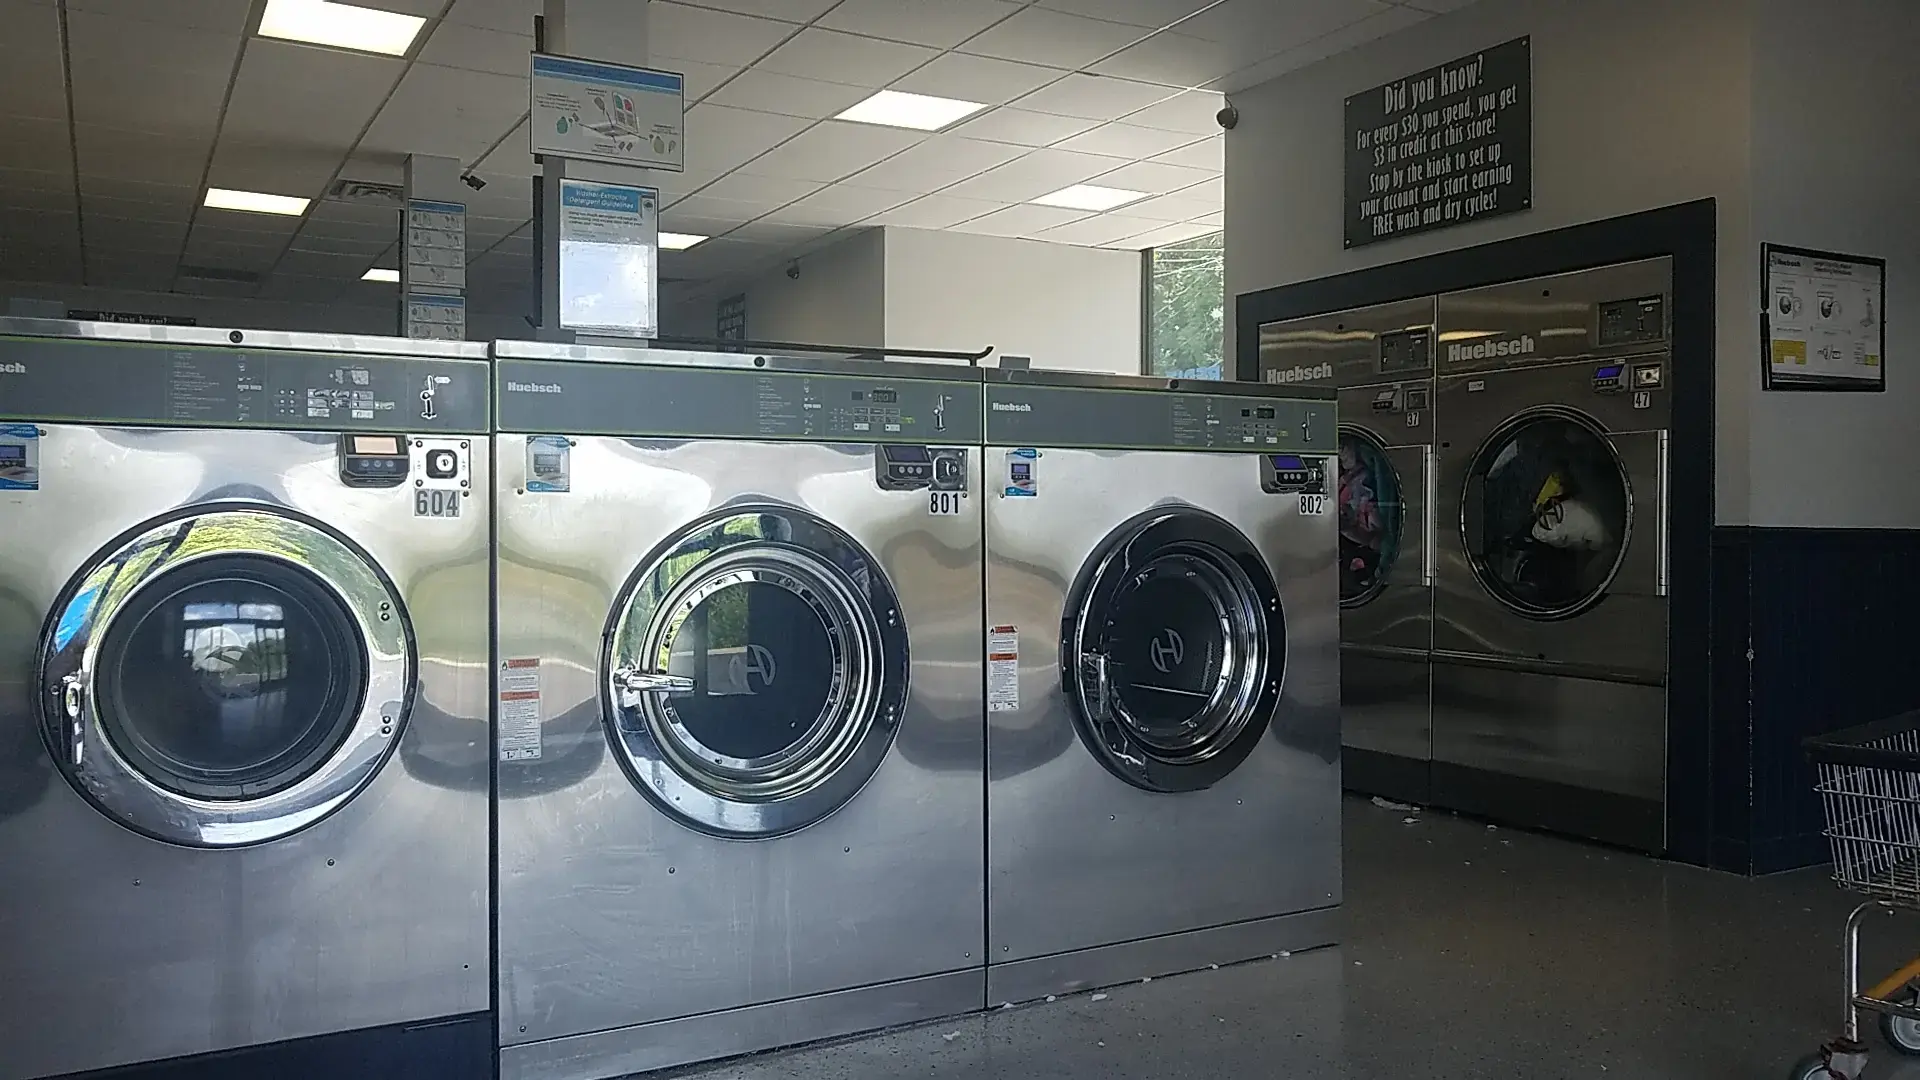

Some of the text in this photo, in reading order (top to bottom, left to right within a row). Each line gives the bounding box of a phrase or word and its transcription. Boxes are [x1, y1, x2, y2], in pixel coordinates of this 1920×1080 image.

[1384, 54, 1484, 115] Did you know?
[1357, 129, 1370, 150] For
[1373, 122, 1399, 145] every
[1422, 110, 1439, 133] you
[1442, 96, 1475, 126] spend,
[1478, 91, 1496, 115] you
[1500, 83, 1517, 110] get
[1387, 143, 1397, 163] in
[1400, 133, 1428, 159] credit
[1430, 131, 1441, 150] at
[1444, 123, 1463, 146] this
[1466, 112, 1496, 141] store!
[1369, 142, 1501, 194] Stop by the kiosk to set up
[1360, 163, 1513, 220] your account and start earning
[1373, 187, 1498, 236] FREE wash and dry cycles!
[1447, 335, 1535, 362] Huebsch
[1266, 362, 1333, 384] Huebsch
[507, 381, 562, 394] Huebsch
[1635, 392, 1650, 408] 47
[992, 401, 1032, 413] Huebsch
[1407, 412, 1419, 426] 37
[415, 490, 459, 517] 604
[929, 491, 961, 515] 801
[1300, 495, 1323, 515] 802
